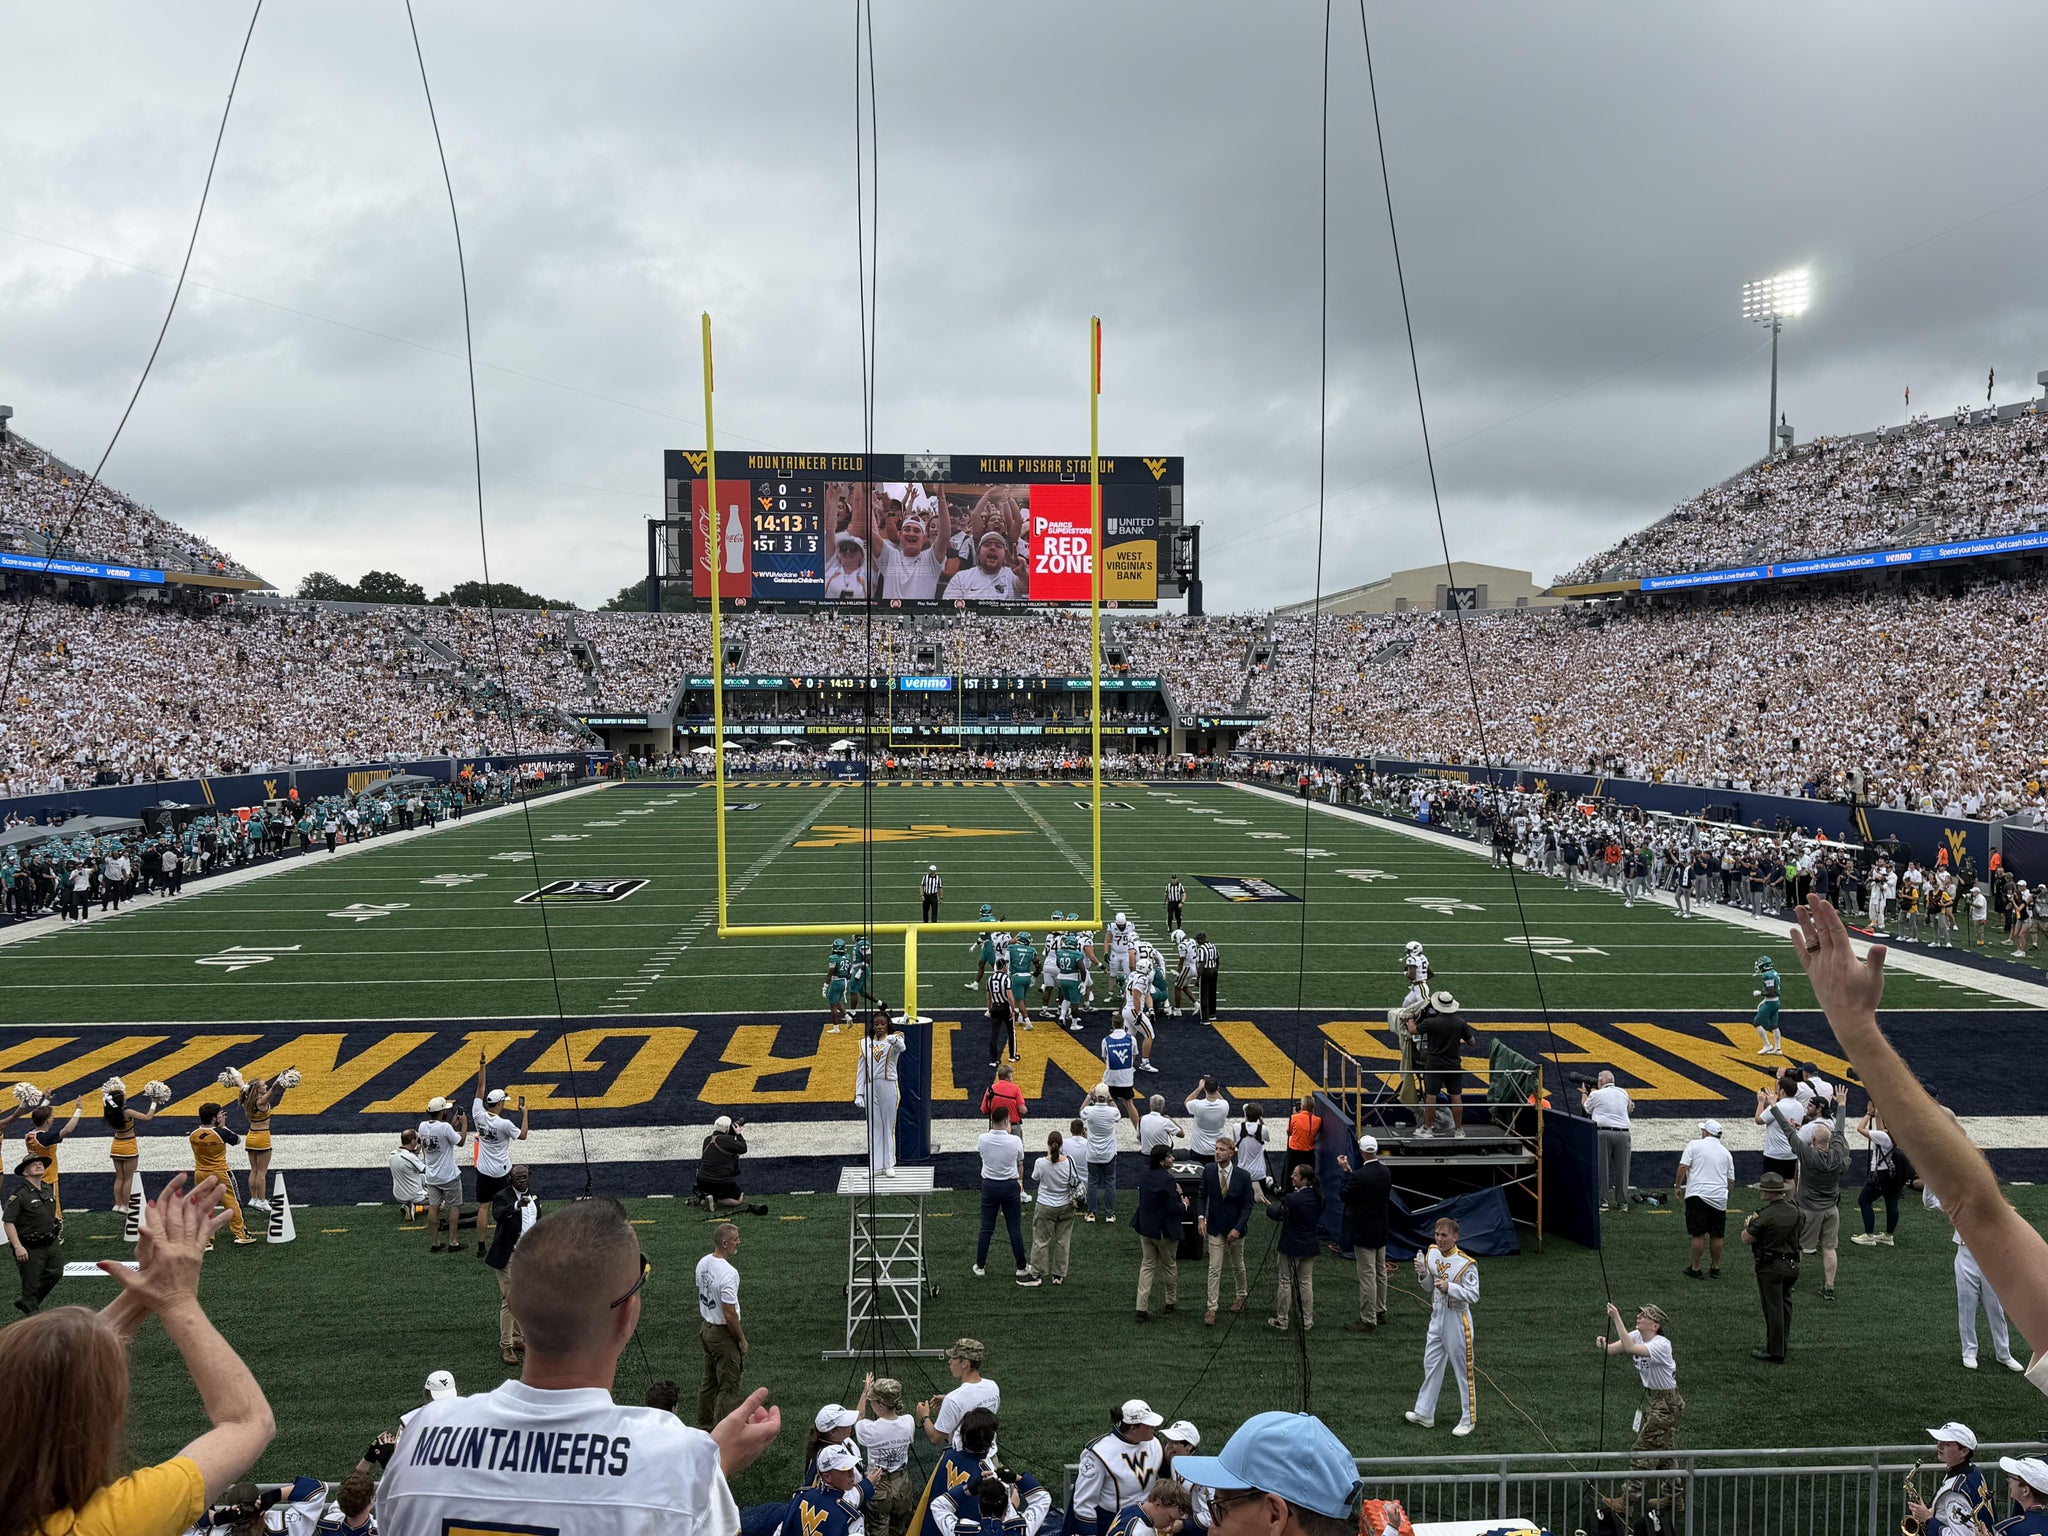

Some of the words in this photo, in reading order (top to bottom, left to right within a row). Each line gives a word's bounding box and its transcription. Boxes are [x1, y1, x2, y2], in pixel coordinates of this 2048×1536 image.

[749, 455, 827, 470] MOUNTAINEER
[831, 456, 863, 471] FIELD
[980, 459, 1013, 473] MILAN
[1018, 459, 1061, 473] PUSKAR
[1066, 460, 1114, 473] STADUM
[779, 484, 787, 495] 0
[779, 500, 787, 510] 0
[754, 515, 803, 532] 14:13
[1119, 518, 1154, 526] UNITED
[753, 540, 775, 551] 1ST
[784, 540, 792, 551] 3
[808, 541, 817, 552] 3
[1044, 537, 1087, 555] RED
[1939, 547, 1959, 557] Spend
[1959, 545, 1971, 555] your
[1972, 543, 1995, 552] balance.
[1996, 541, 2007, 550] Get
[2007, 539, 2022, 548] cash
[2023, 536, 2039, 546] back.
[1117, 552, 1142, 560] WEST
[1885, 552, 1912, 563] venmo
[2, 557, 18, 565] Score
[18, 559, 31, 568] more
[32, 560, 43, 568] with
[53, 562, 71, 571] Venmo
[71, 564, 85, 573] Debit
[1035, 555, 1093, 573] ZONE
[1106, 562, 1153, 570] VIRGINIA'S
[1782, 565, 1796, 574] Score
[1809, 563, 1820, 571] with
[1821, 562, 1829, 570] the
[1829, 560, 1846, 569] Venmo
[1847, 559, 1860, 567] Debit
[1861, 557, 1875, 566] Card.
[107, 568, 130, 577] venmo
[1117, 572, 1143, 580] BANK
[806, 679, 814, 688] 0
[830, 679, 854, 688] 14:13
[870, 679, 877, 688] 0
[905, 678, 947, 688] venmo
[963, 679, 979, 689] 1ST
[992, 679, 999, 689] 3
[1017, 679, 1024, 689] 3
[1040, 679, 1046, 689] 1
[1181, 717, 1193, 726] 40
[744, 726, 759, 734] WEST
[781, 726, 804, 734] AIRPORT
[1018, 953, 1025, 965] 7
[1060, 957, 1072, 970] 92
[992, 980, 1000, 993] B
[125, 1193, 142, 1236] WVU
[269, 1194, 285, 1237] WVU
[409, 1426, 631, 1476] MOUNTAINEERS
